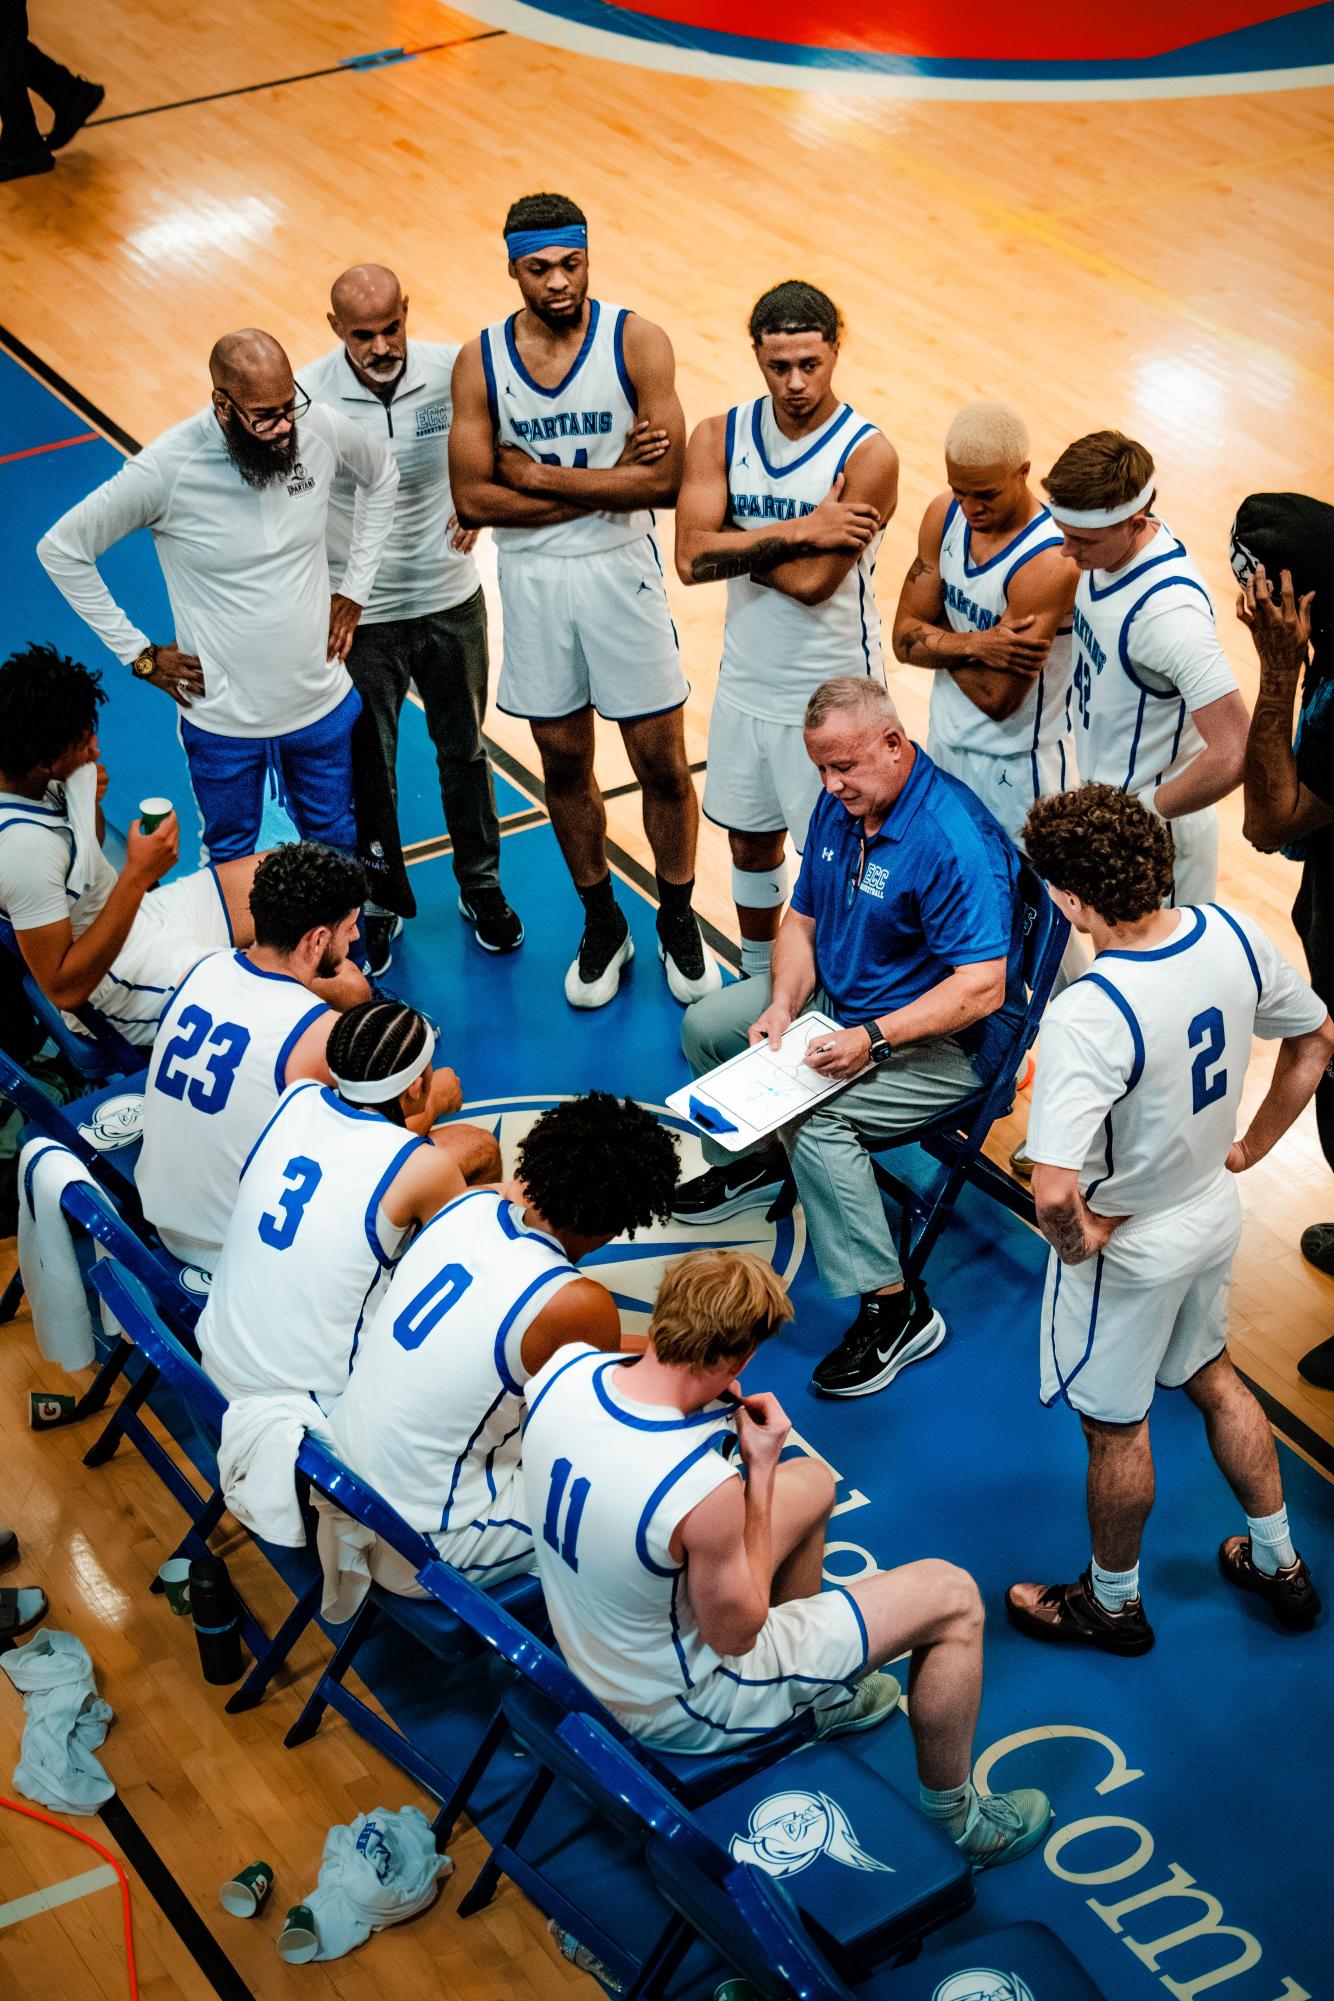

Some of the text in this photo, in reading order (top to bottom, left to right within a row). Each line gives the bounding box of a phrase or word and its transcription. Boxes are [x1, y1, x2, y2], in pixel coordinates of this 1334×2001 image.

[416, 404, 447, 430] ECC
[730, 493, 818, 521] SPARTAN
[1073, 650, 1092, 730] 42
[863, 862, 889, 891] ECC
[154, 1003, 251, 1116] 23
[1187, 1005, 1228, 1116] 2
[257, 1154, 323, 1252] 3
[392, 1262, 474, 1352] 0
[543, 1457, 592, 1575] 11
[972, 1724, 1313, 2001] Com
